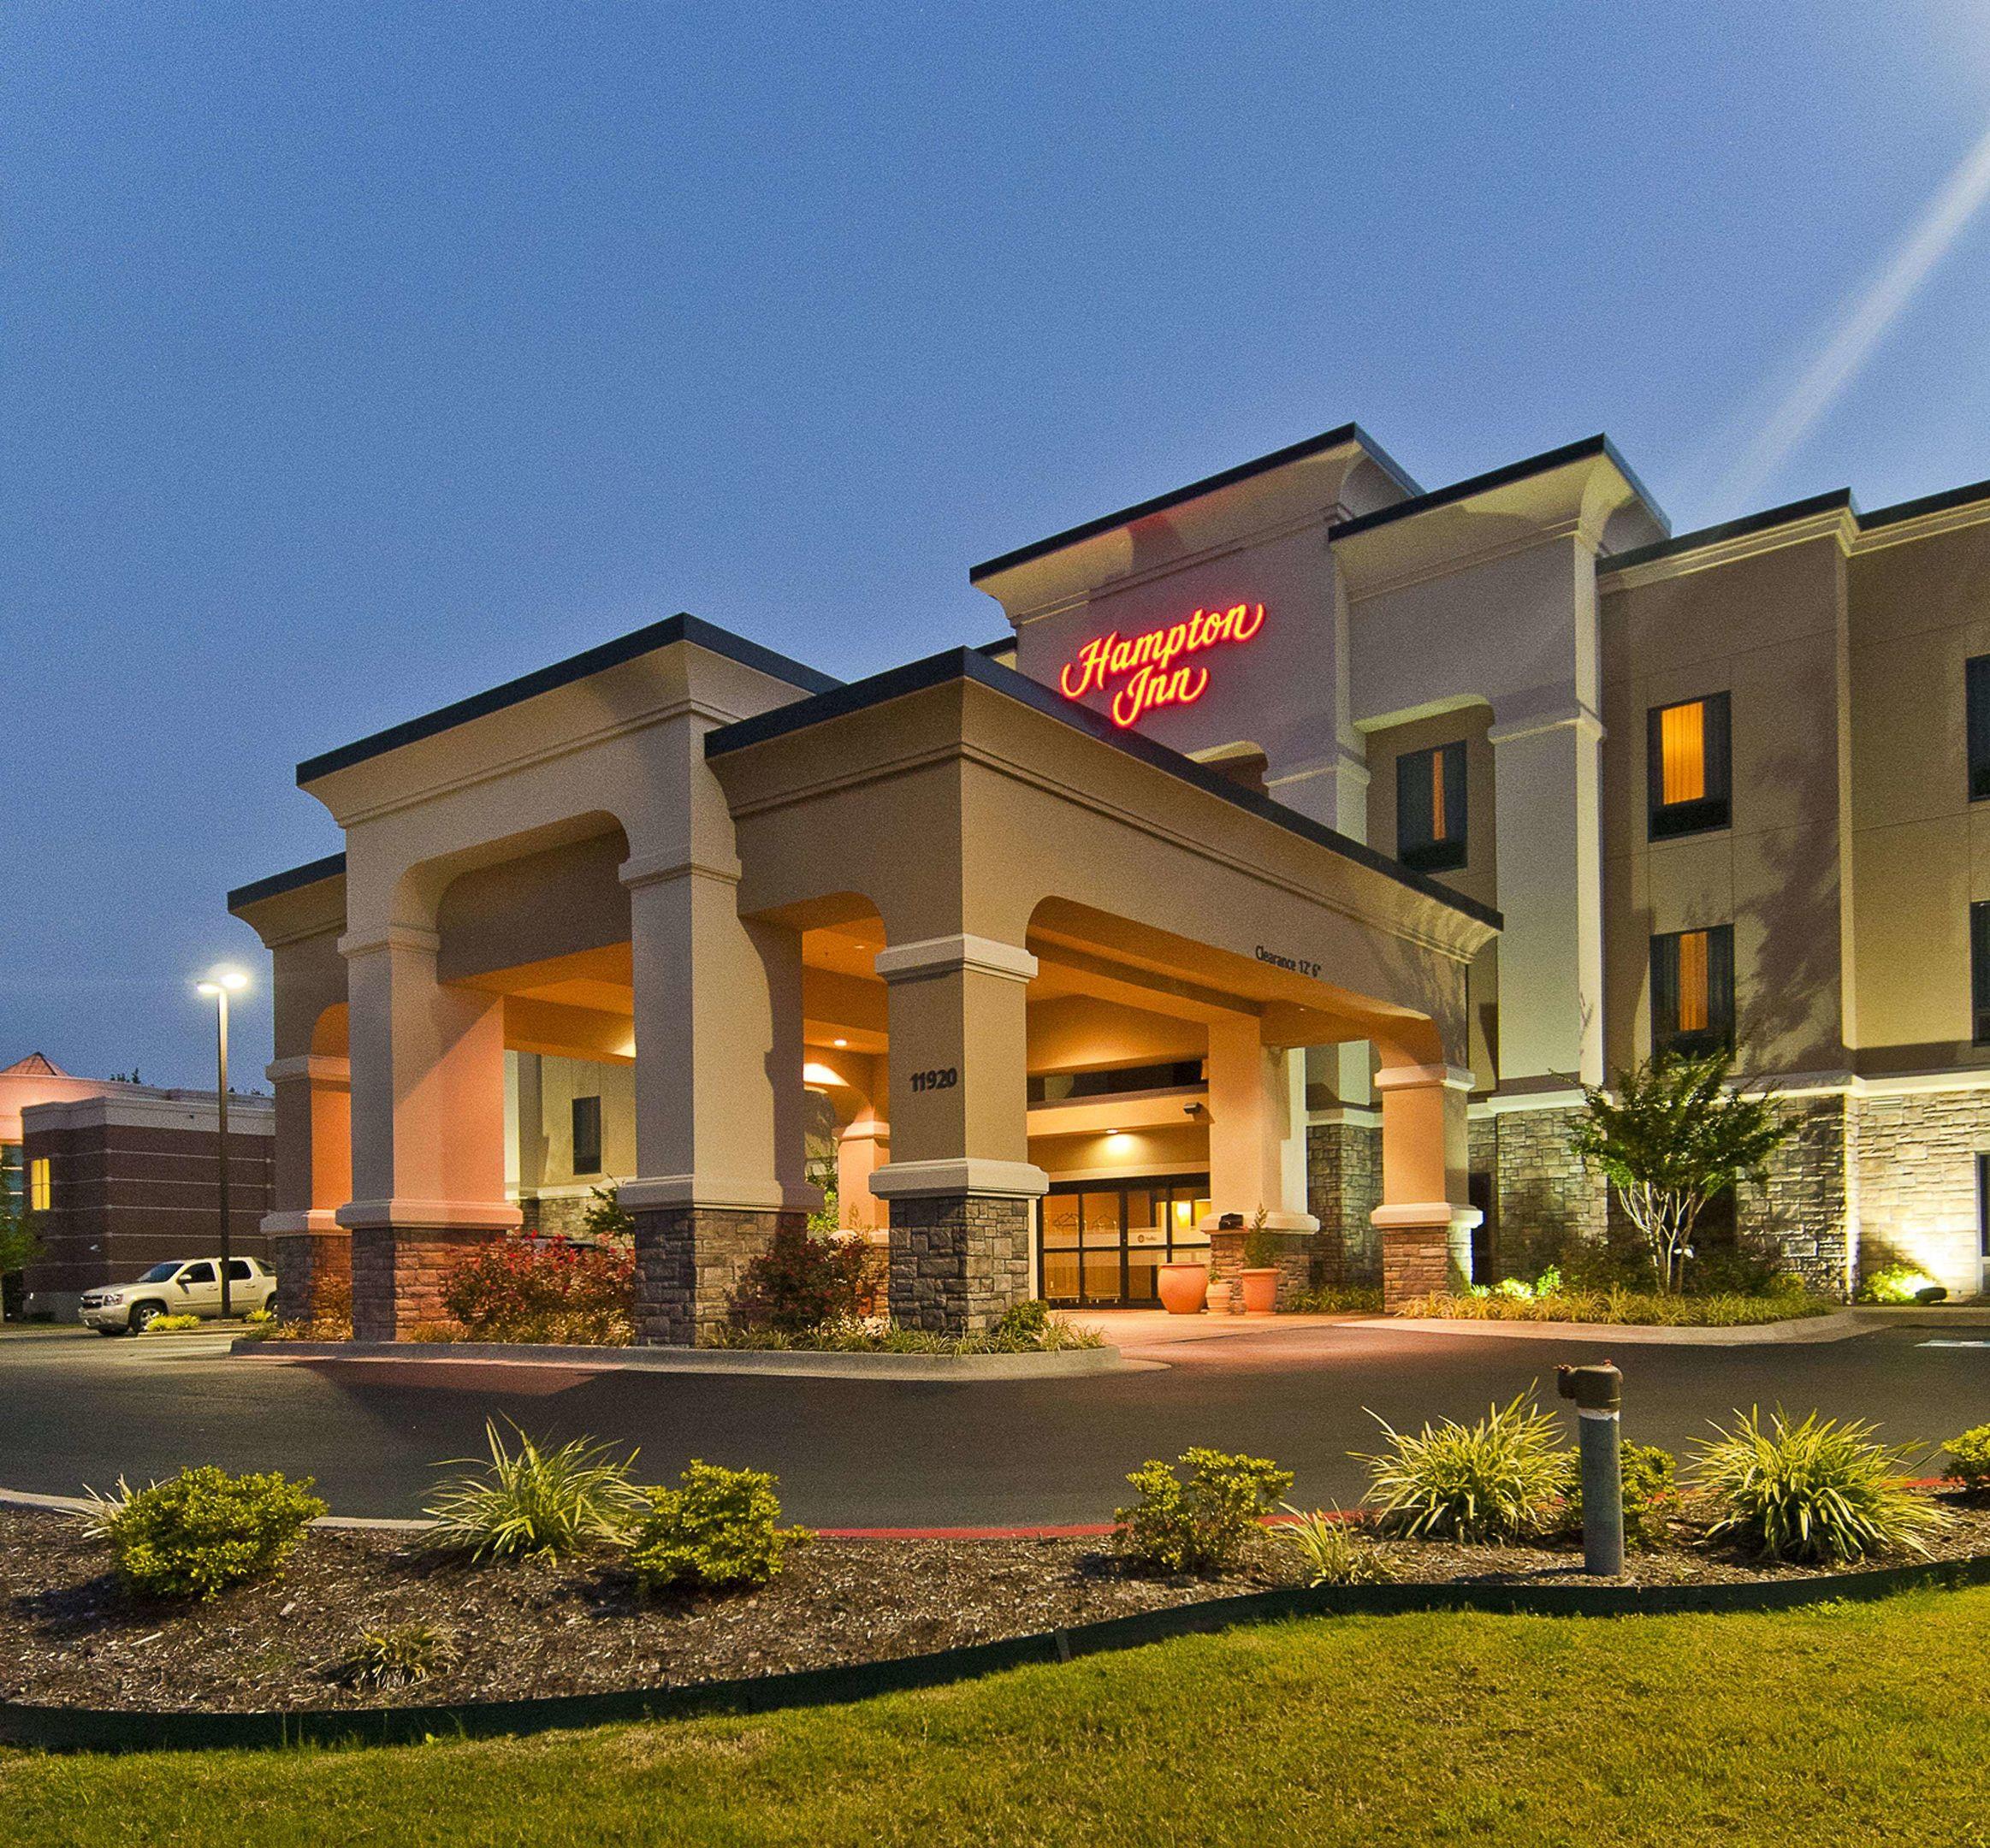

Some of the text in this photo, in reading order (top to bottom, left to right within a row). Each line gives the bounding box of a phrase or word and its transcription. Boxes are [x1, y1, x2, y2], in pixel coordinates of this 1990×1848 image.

[1060, 602, 1264, 698] Hampton
[1111, 664, 1209, 727] Inn
[1256, 945, 1296, 971] Clearance
[909, 1068, 957, 1093] 11920
